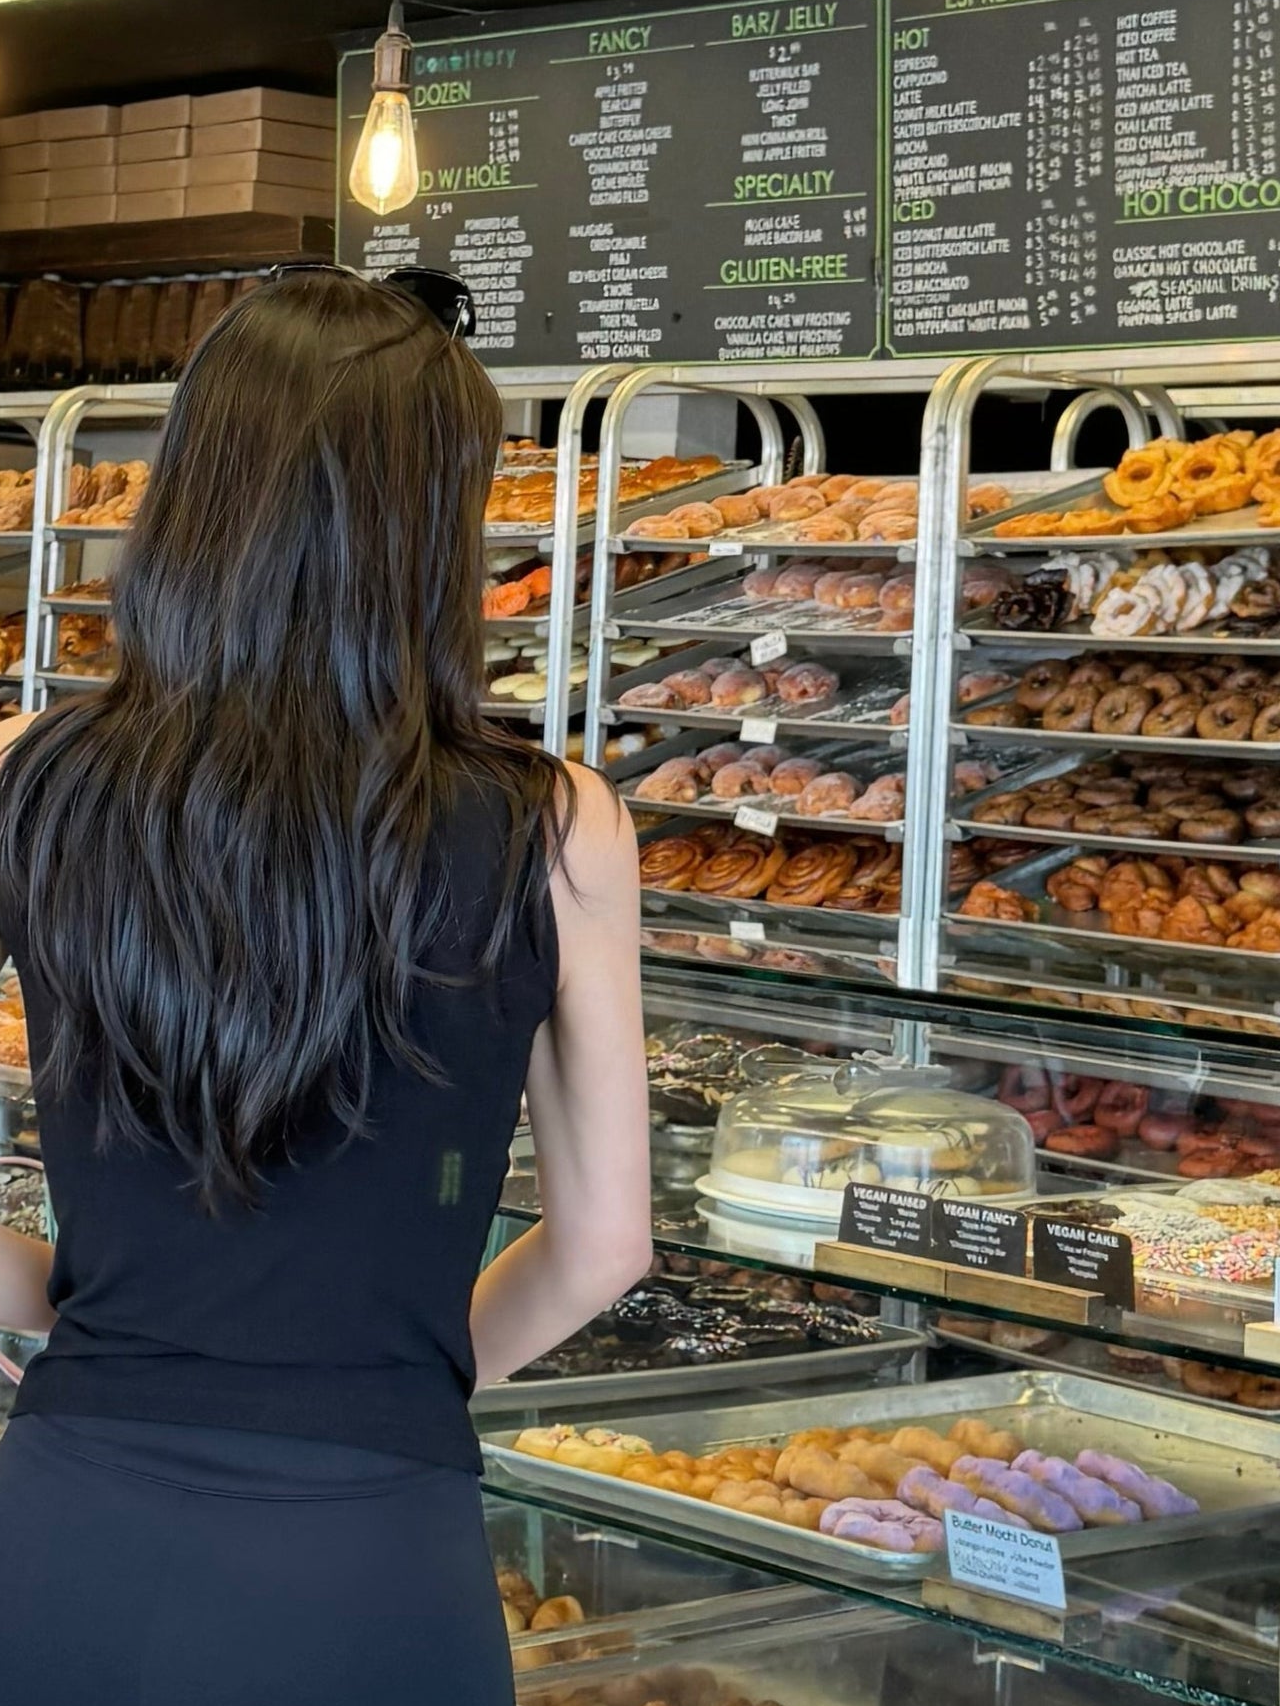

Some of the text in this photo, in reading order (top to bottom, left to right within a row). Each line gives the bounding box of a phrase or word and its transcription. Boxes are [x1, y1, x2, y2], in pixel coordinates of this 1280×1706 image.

[732, 2, 838, 37] BAR/ JELLY
[1141, 9, 1177, 27] COFFEE
[589, 26, 652, 53] FANCY
[894, 28, 930, 51] HOT
[1141, 28, 1176, 44] COFFEE
[1139, 47, 1159, 62] TEA
[1166, 62, 1189, 76] TEA
[415, 81, 471, 107] DOZEN
[1159, 78, 1191, 94] LATTE
[894, 90, 922, 106] LATTE
[992, 112, 1022, 128] LATTE
[1142, 116, 1172, 131] LATTE
[438, 168, 463, 190] W/
[466, 163, 511, 188] HOLE
[734, 170, 835, 199] SPECIALTY
[893, 201, 935, 222] ICED
[1124, 189, 1173, 217] HOT
[981, 239, 1010, 253] LATTE
[1113, 240, 1245, 262] CLASSIC HOT CHOCOLATE
[720, 254, 848, 283] GLUTEN-FREE
[1161, 279, 1227, 295] SEASONAL
[852, 1187, 927, 1209] VEGAN RAISED
[943, 1203, 1018, 1226] VEGAN FANCY
[1046, 1224, 1120, 1248] VEGAN CAKE
